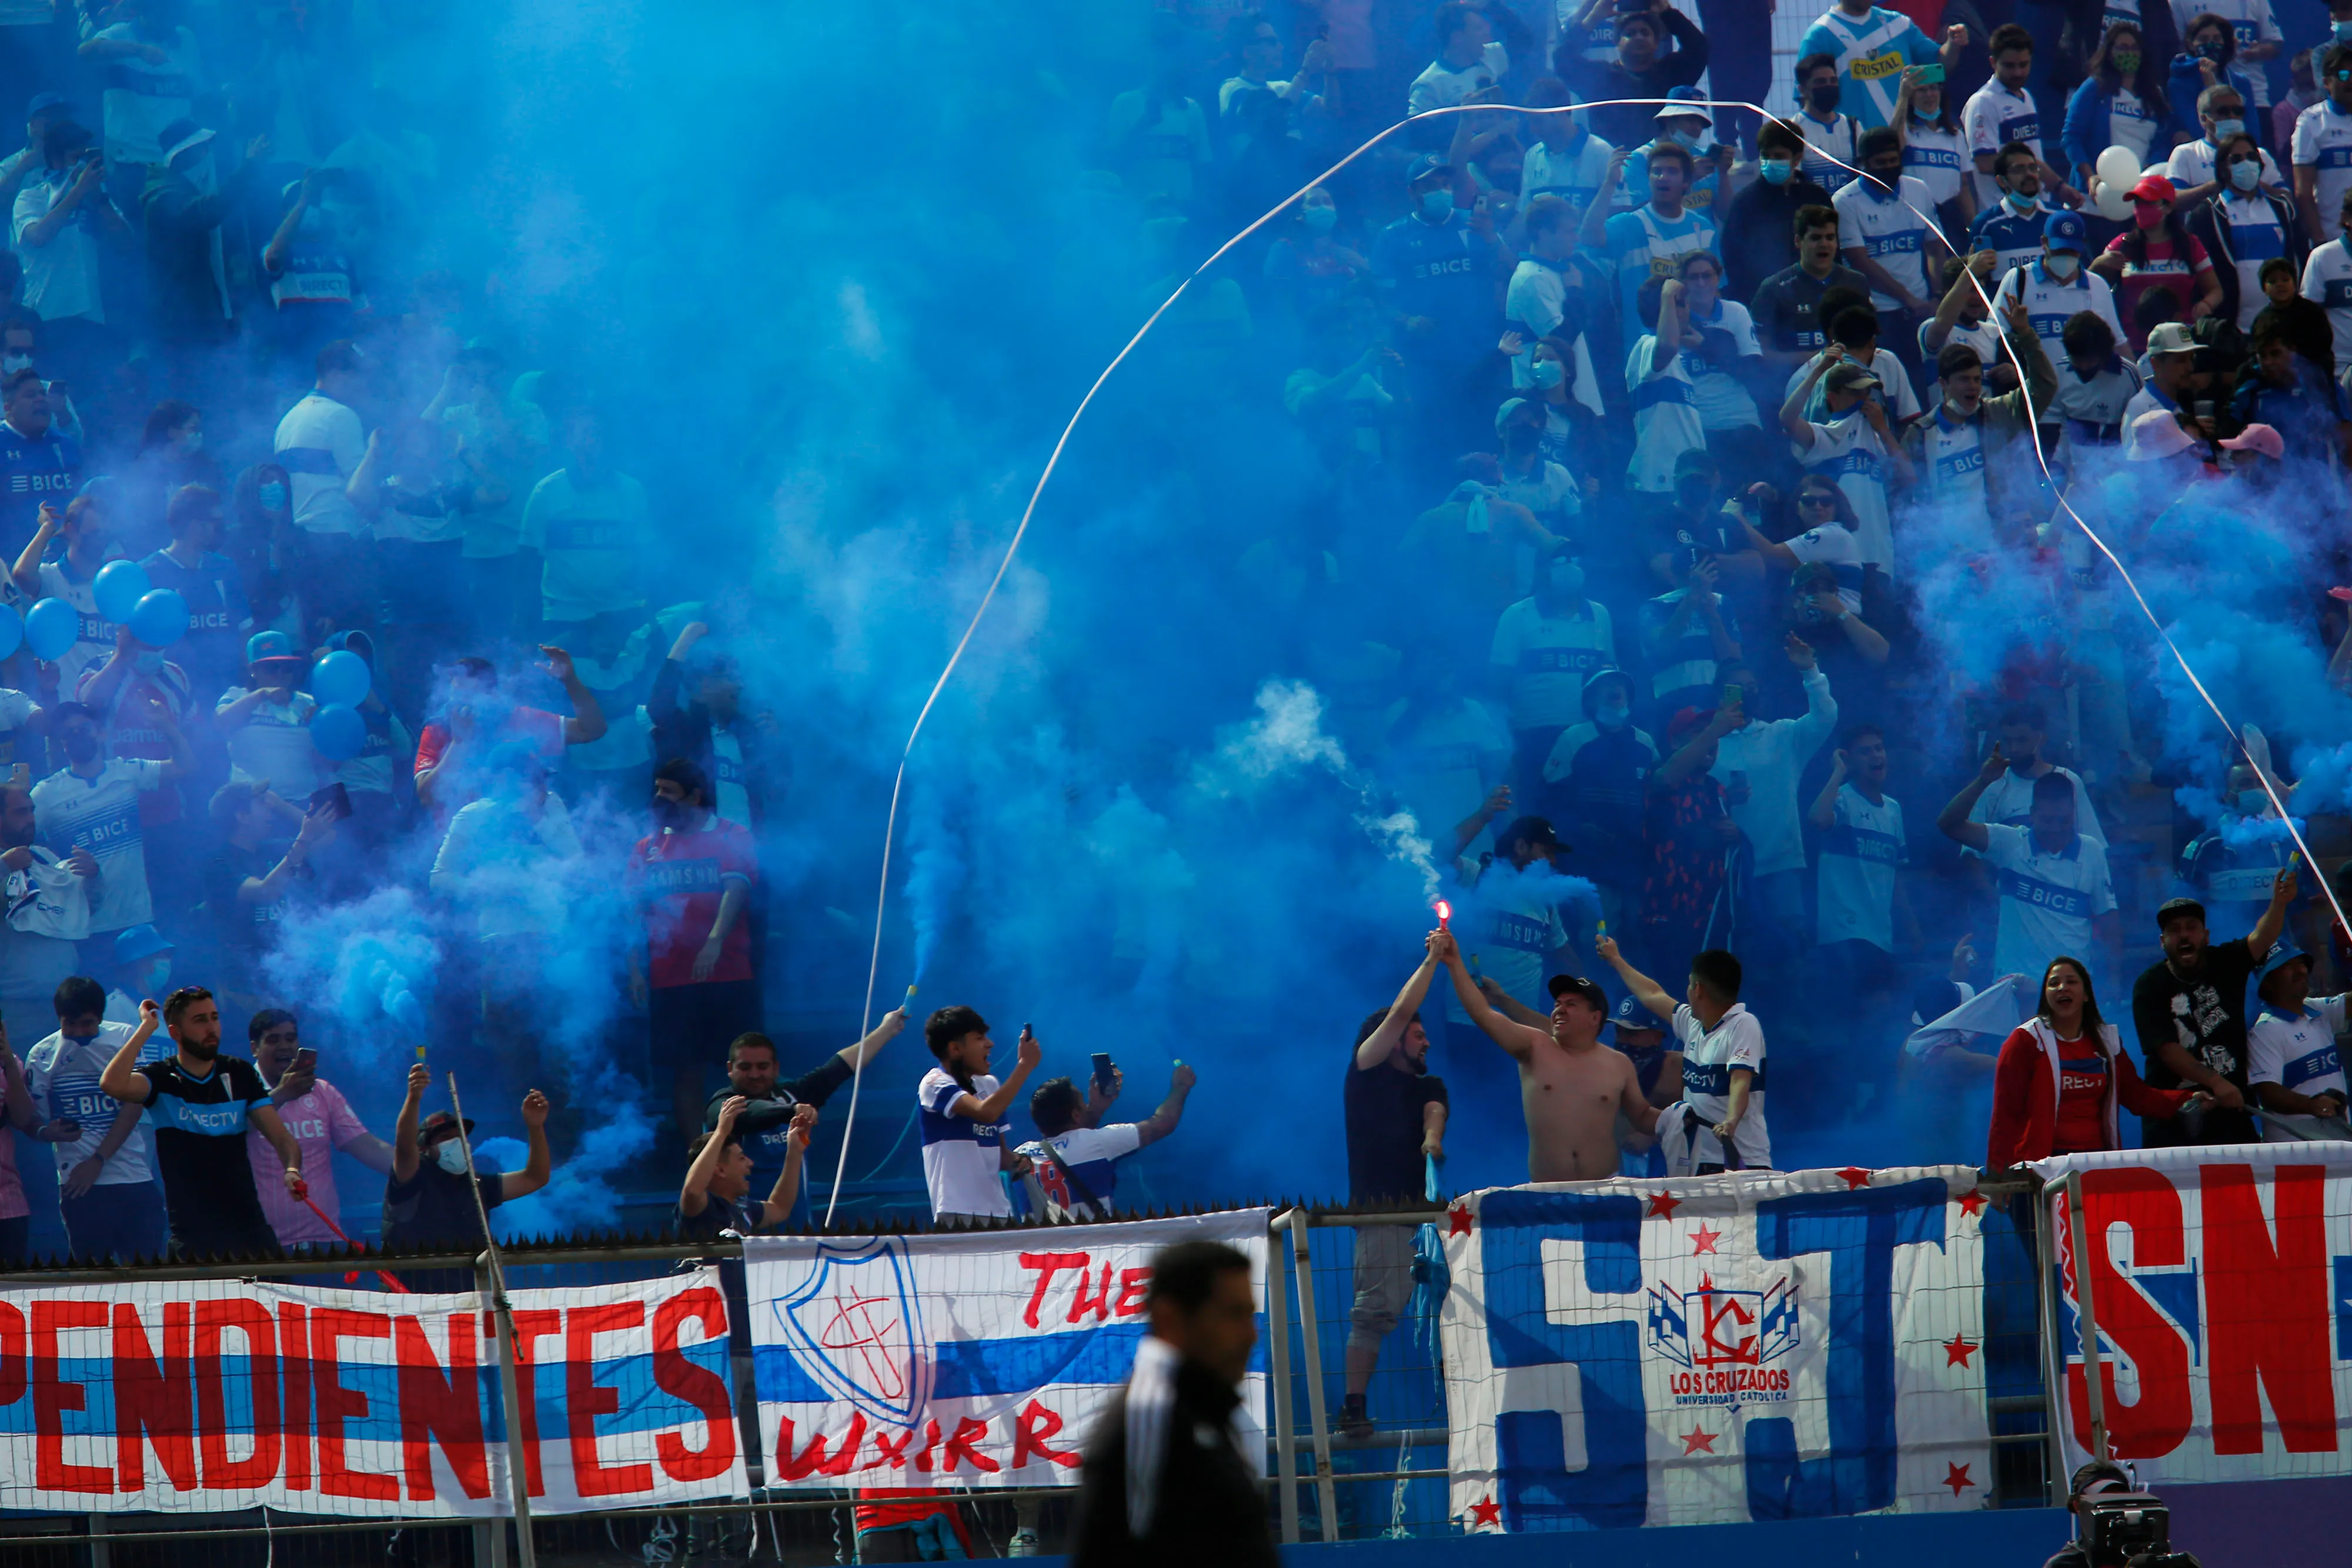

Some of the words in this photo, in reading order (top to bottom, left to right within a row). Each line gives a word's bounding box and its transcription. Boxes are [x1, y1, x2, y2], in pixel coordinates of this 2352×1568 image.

[2233, 27, 2253, 44] CE
[1854, 57, 1900, 75] CRISTAL
[1927, 152, 1960, 166] BICE
[1828, 174, 1847, 187] BIC
[1561, 193, 1581, 206] CE
[1880, 236, 1915, 253] BICE
[1430, 258, 1471, 276] BICE
[2009, 255, 2038, 270] DIRE
[1538, 441, 1563, 462] BIC
[1856, 457, 1881, 478] BIE
[1954, 453, 1983, 473] BIC
[32, 473, 72, 491] BICE
[86, 620, 113, 640] BIC
[189, 613, 228, 629] BICE
[92, 818, 129, 842] BICE
[2227, 875, 2276, 891] DIRECT
[2032, 887, 2077, 912] BICE
[1018, 1251, 1154, 1329] THE
[1670, 1372, 1702, 1395] LOS
[1705, 1369, 1790, 1395] CRUZADOS
[1676, 1393, 1735, 1406] UNIVERSIDAD
